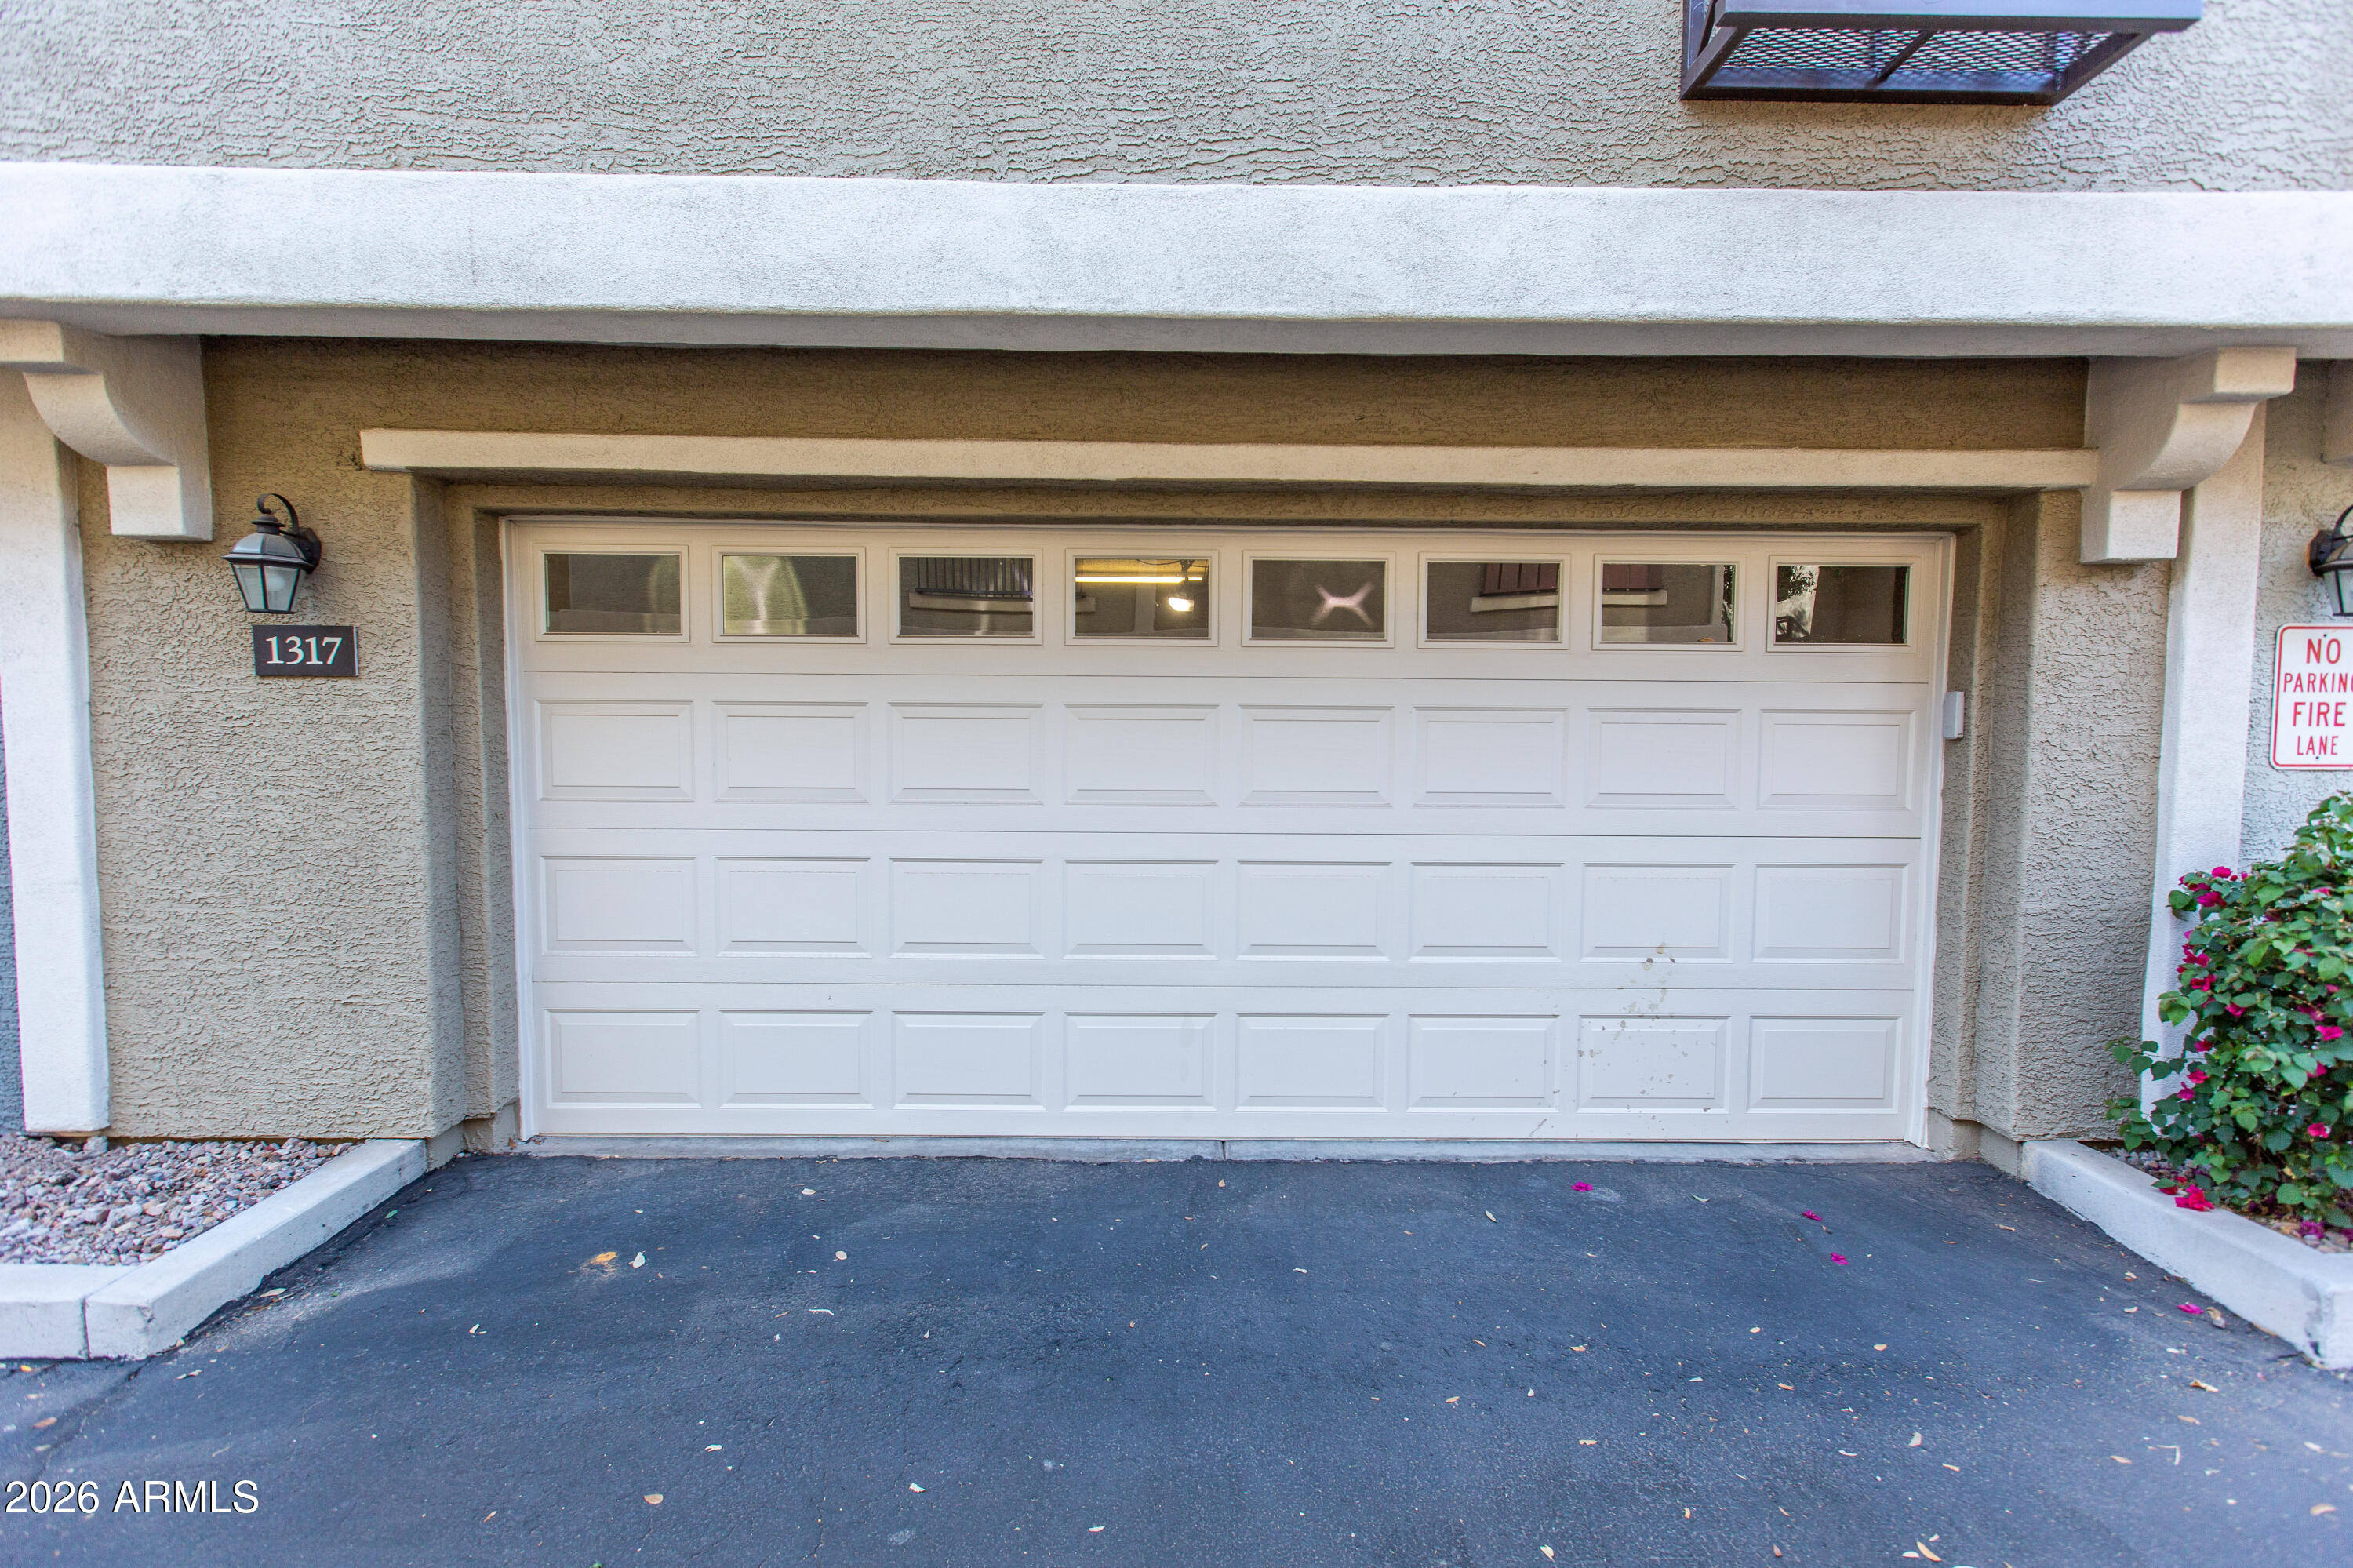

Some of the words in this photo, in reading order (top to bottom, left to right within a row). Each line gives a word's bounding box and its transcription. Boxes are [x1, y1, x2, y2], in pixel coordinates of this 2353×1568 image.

[265, 635, 343, 665] 1317
[2306, 638, 2341, 664] NO
[2283, 672, 2353, 693] PARKIN
[2293, 702, 2347, 726] FIRE
[2297, 735, 2339, 755] LANE
